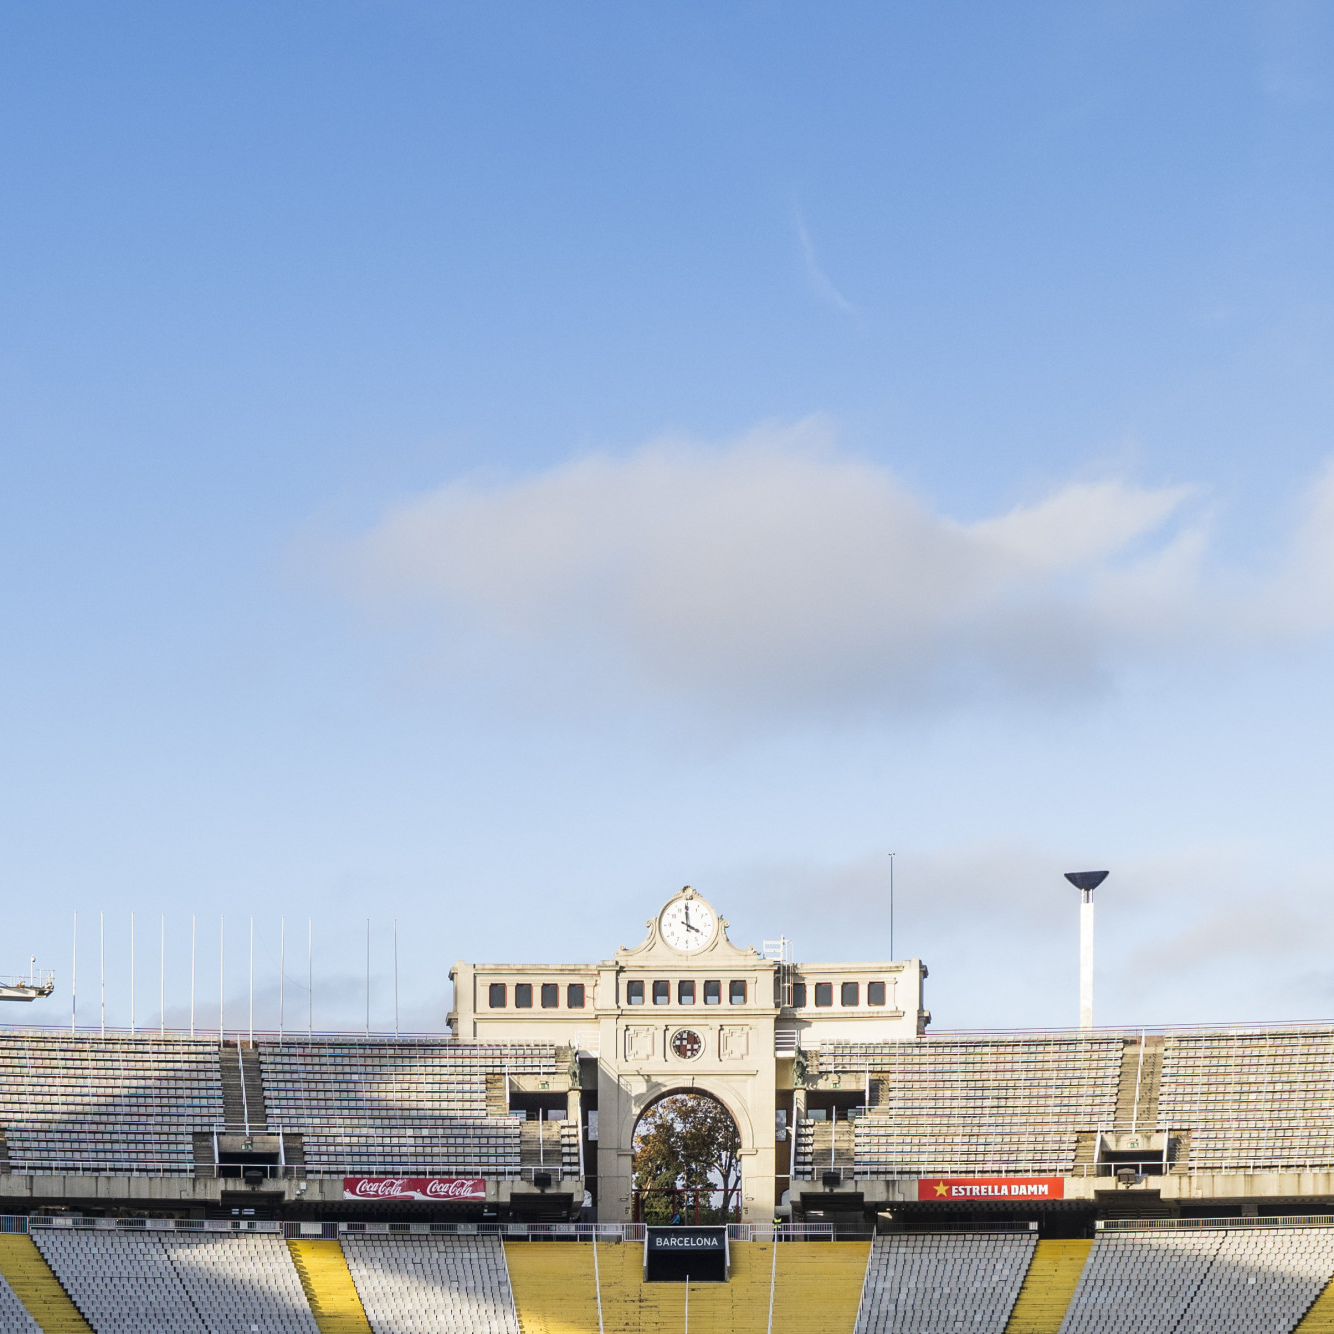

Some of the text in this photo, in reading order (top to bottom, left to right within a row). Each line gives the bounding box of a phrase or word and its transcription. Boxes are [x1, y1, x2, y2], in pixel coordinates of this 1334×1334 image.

[356, 1179, 404, 1195] Coca-Cola
[427, 1179, 475, 1195] Coca-Cola
[951, 1184, 1049, 1196] ESTRELLA DAMM
[655, 1237, 719, 1247] BARCELONA
